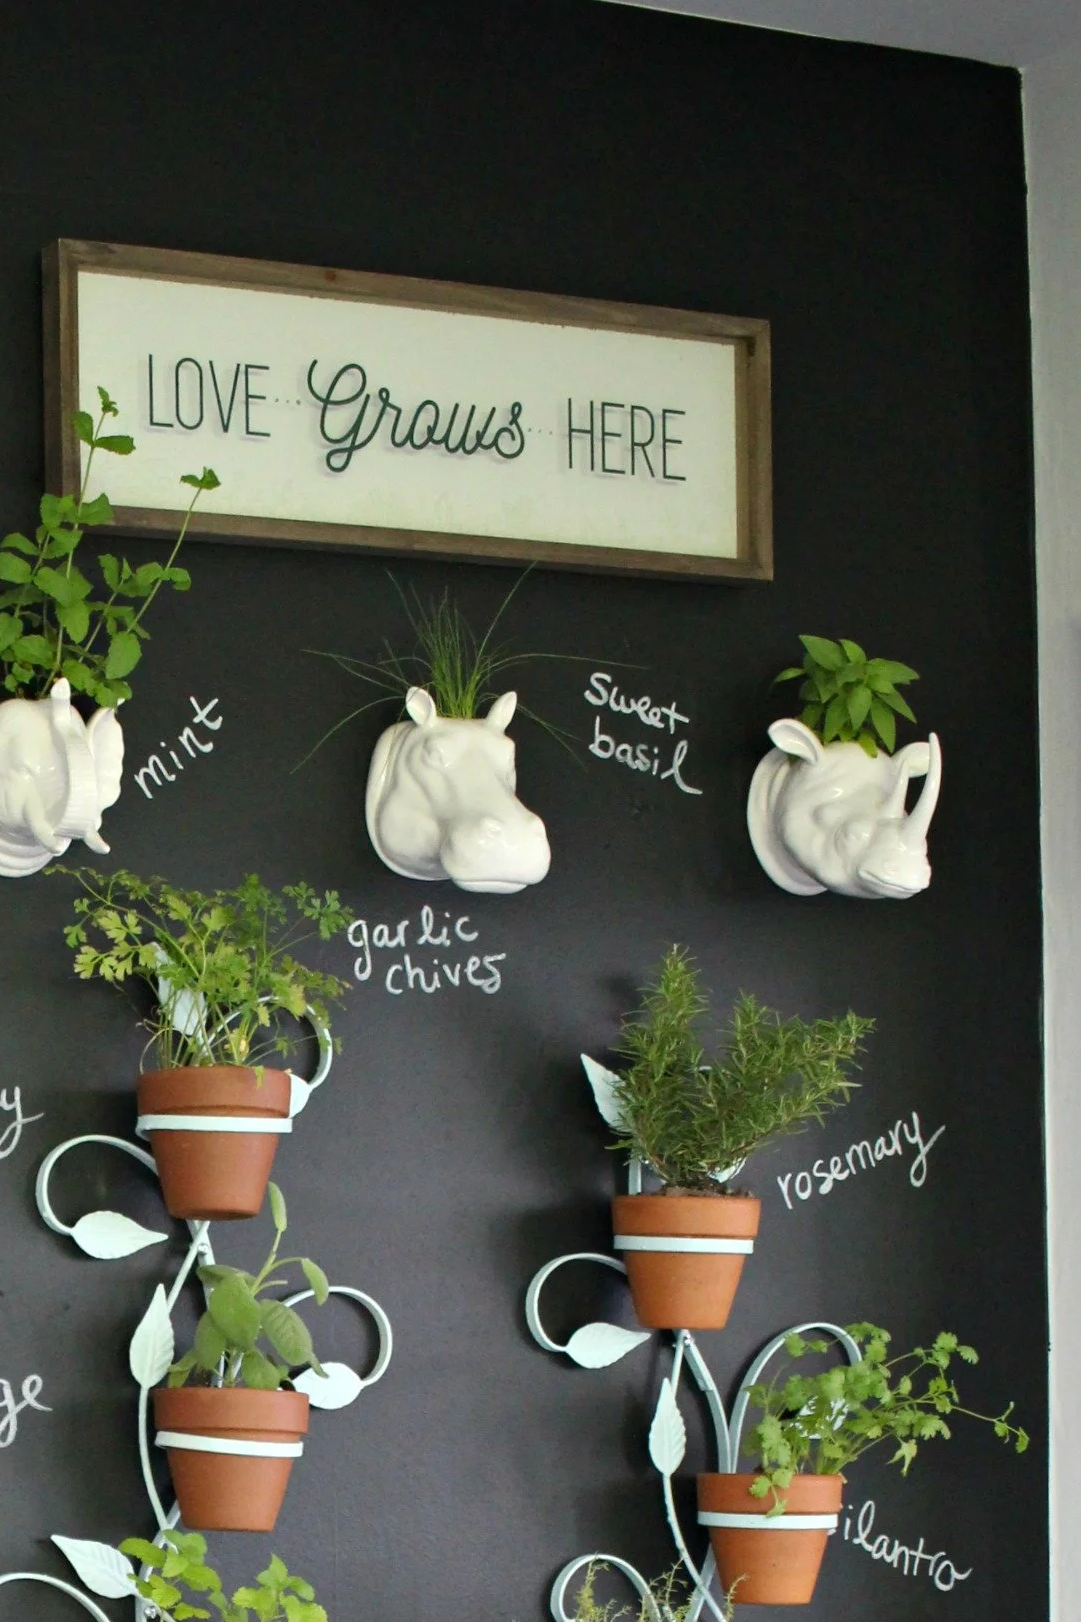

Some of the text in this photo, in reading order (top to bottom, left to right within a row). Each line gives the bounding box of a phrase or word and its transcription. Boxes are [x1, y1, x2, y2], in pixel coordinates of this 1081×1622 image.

[147, 353, 688, 482] LOVE Grows HERE
[133, 695, 224, 801] mint
[588, 715, 703, 795] basil
[346, 904, 480, 982] garlic
[385, 952, 507, 995] chives
[776, 1111, 946, 1211] rosemary
[827, 1499, 974, 1592] ilantro
